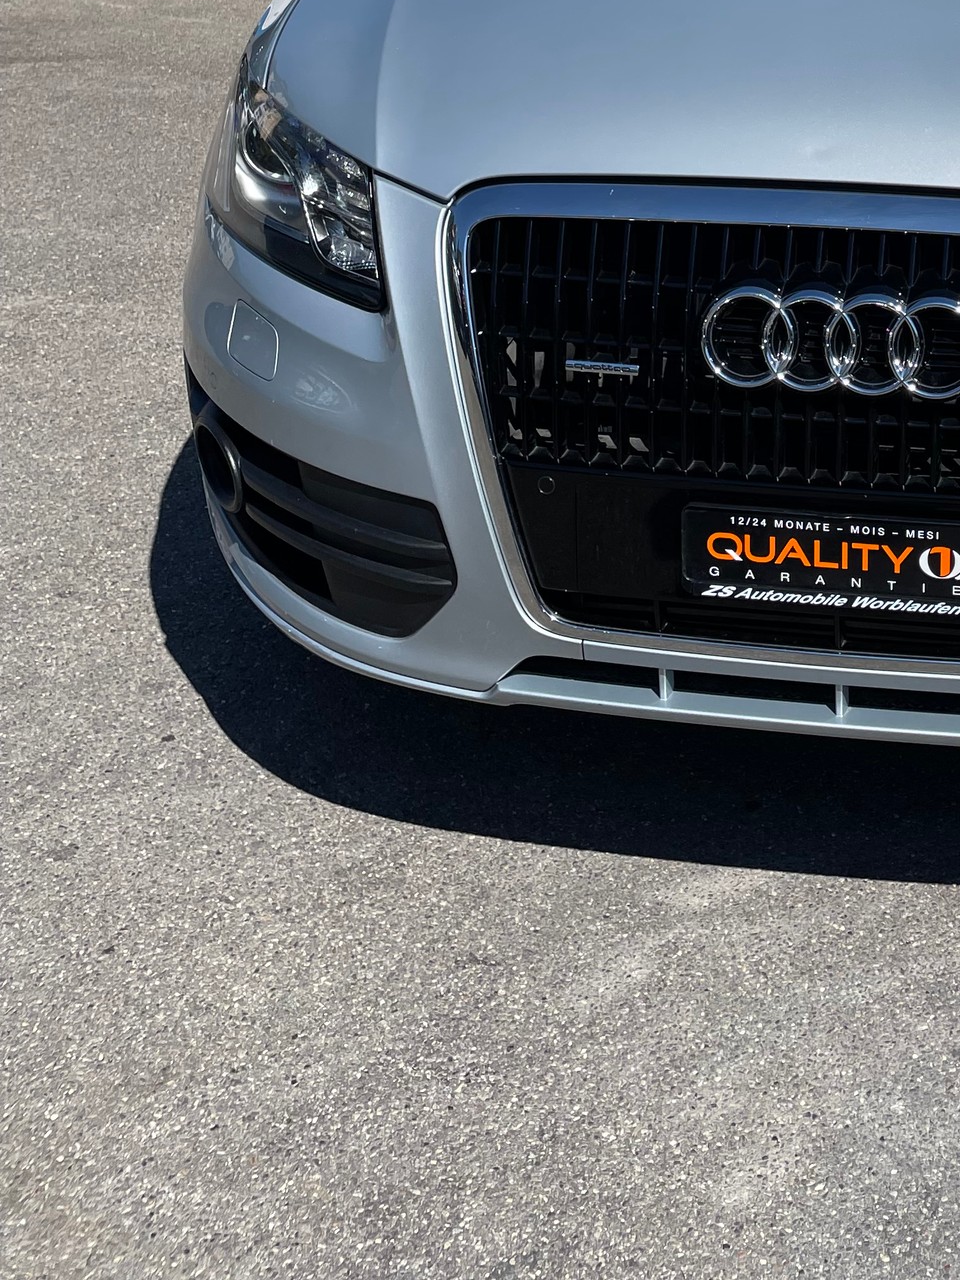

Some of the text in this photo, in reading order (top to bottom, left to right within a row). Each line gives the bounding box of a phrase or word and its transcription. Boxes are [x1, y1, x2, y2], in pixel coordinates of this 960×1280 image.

[730, 516, 767, 527] 12/24
[774, 519, 830, 532] MONATE
[850, 525, 885, 536] MOIS
[905, 529, 940, 540] MESI
[707, 532, 914, 574] QUALITY
[709, 566, 960, 596] GARANTIE
[701, 584, 736, 597] ZS
[734, 587, 848, 606] Automobile
